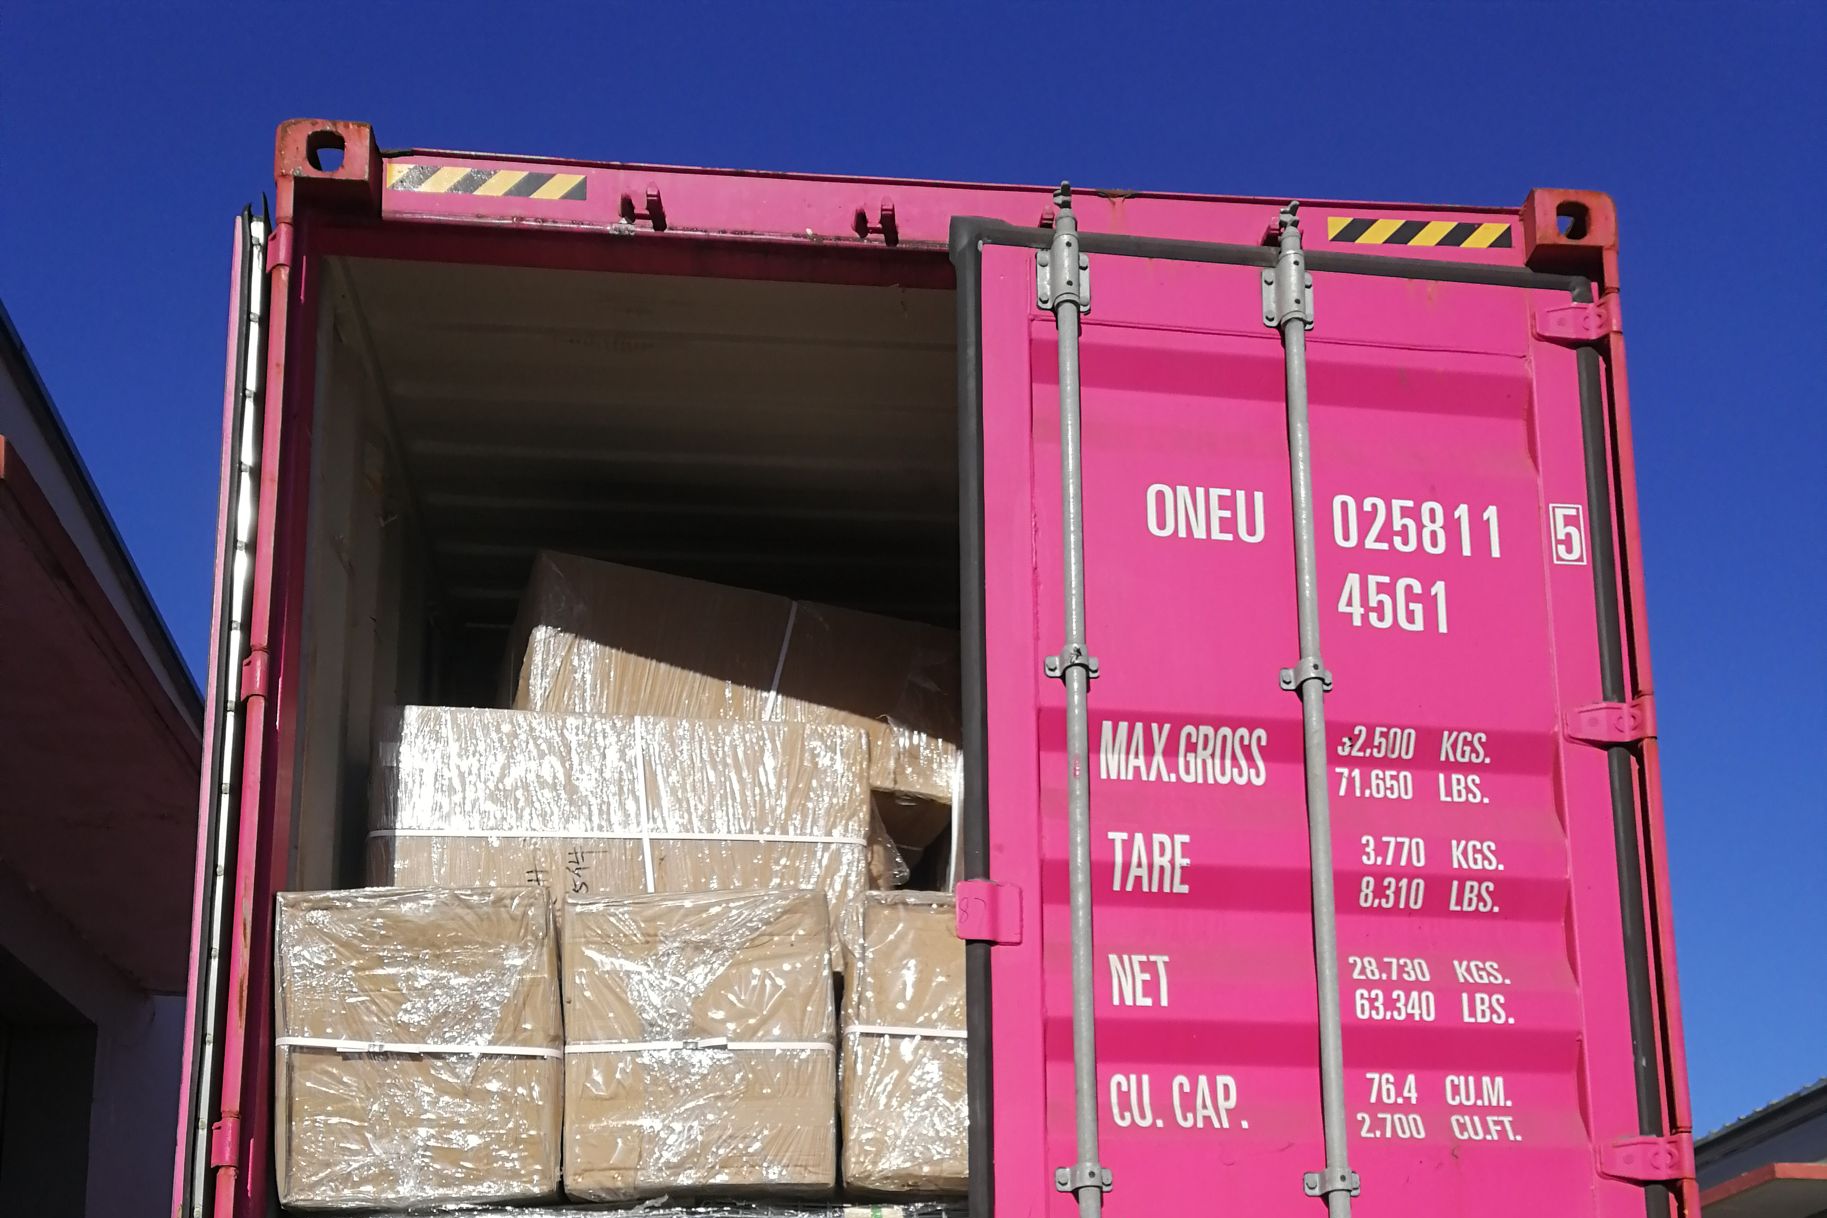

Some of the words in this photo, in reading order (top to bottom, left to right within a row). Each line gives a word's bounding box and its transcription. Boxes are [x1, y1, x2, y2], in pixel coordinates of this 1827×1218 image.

[1146, 483, 1265, 544] ONEU
[1332, 494, 1501, 558] 025811
[1555, 508, 1583, 561] 5
[1337, 572, 1448, 634] 45G1
[1099, 720, 1267, 786] MAX.GROSS
[1440, 730, 1490, 764] KGS.
[1438, 773, 1490, 804] LBS.
[1107, 831, 1191, 893] TARE
[1451, 839, 1504, 871] KGS.
[1449, 880, 1499, 913] LBS.
[1108, 953, 1170, 1007] NET
[1453, 959, 1511, 985] KGS.
[1461, 992, 1515, 1024] LBS.
[1110, 1073, 1164, 1128] CU.
[1172, 1074, 1249, 1129] CAP.
[1365, 1072, 1418, 1105] 76.4
[1445, 1074, 1513, 1107] CU.M.
[1450, 1114, 1522, 1141] CU.FT.
